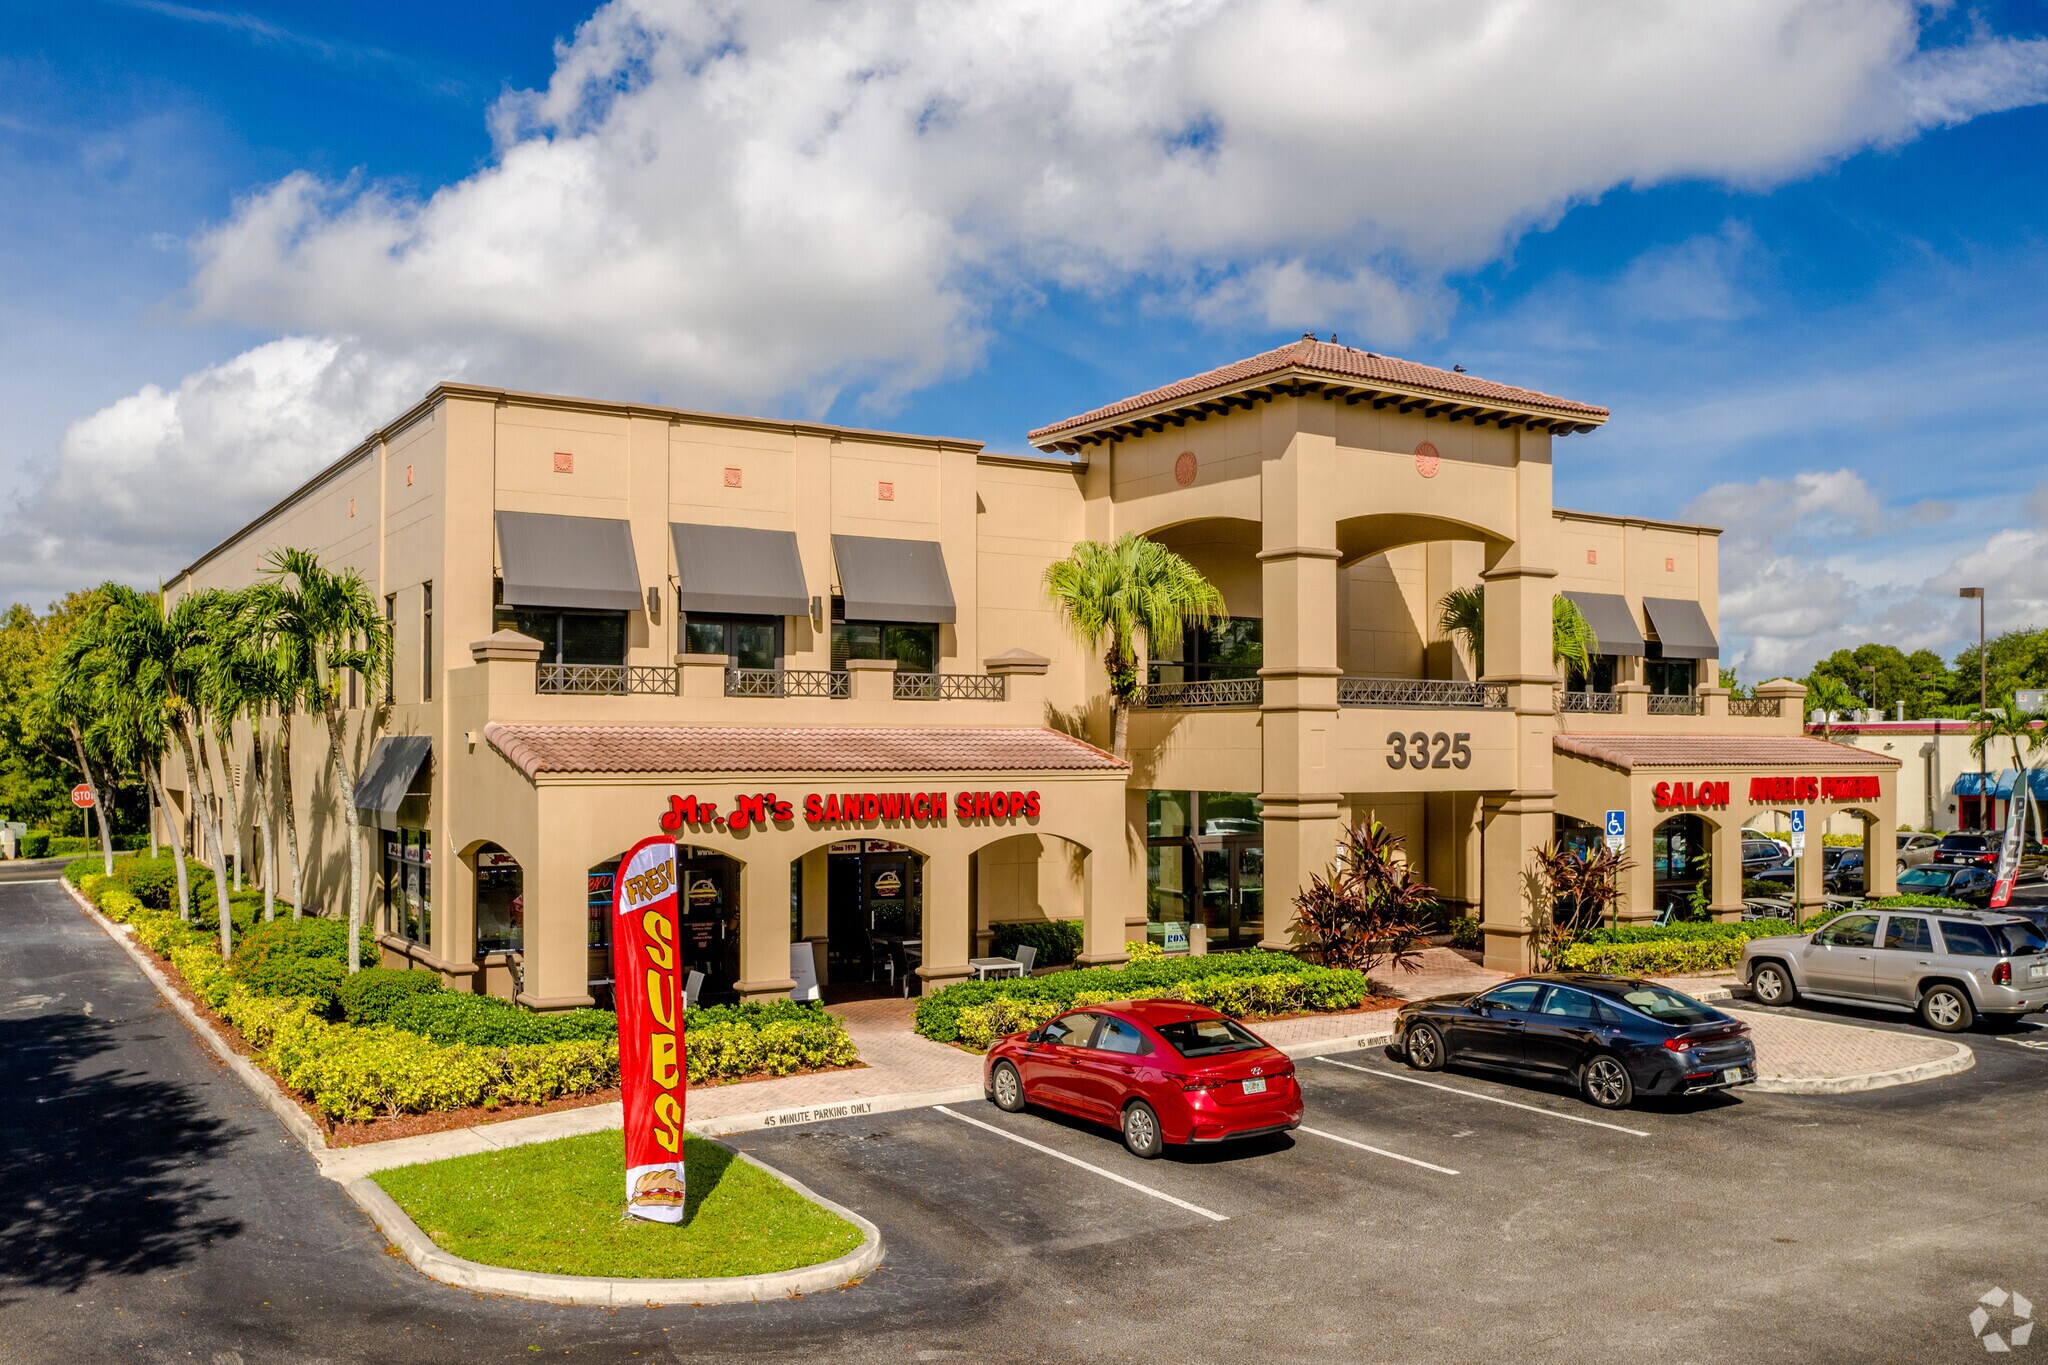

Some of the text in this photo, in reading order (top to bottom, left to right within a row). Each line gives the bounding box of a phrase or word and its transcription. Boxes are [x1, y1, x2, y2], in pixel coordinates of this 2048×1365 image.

[1386, 731, 1471, 770] 3325
[74, 791, 94, 801] STO
[1655, 781, 1729, 807] SALON
[661, 790, 1041, 830] Mr. M's SANDWICH SHOPS
[831, 844, 844, 852] Since
[642, 909, 682, 1154] SUBS
[1367, 1036, 1388, 1047] MINUTE
[764, 1103, 872, 1126] 45 MINUTE PARKING ONLY
